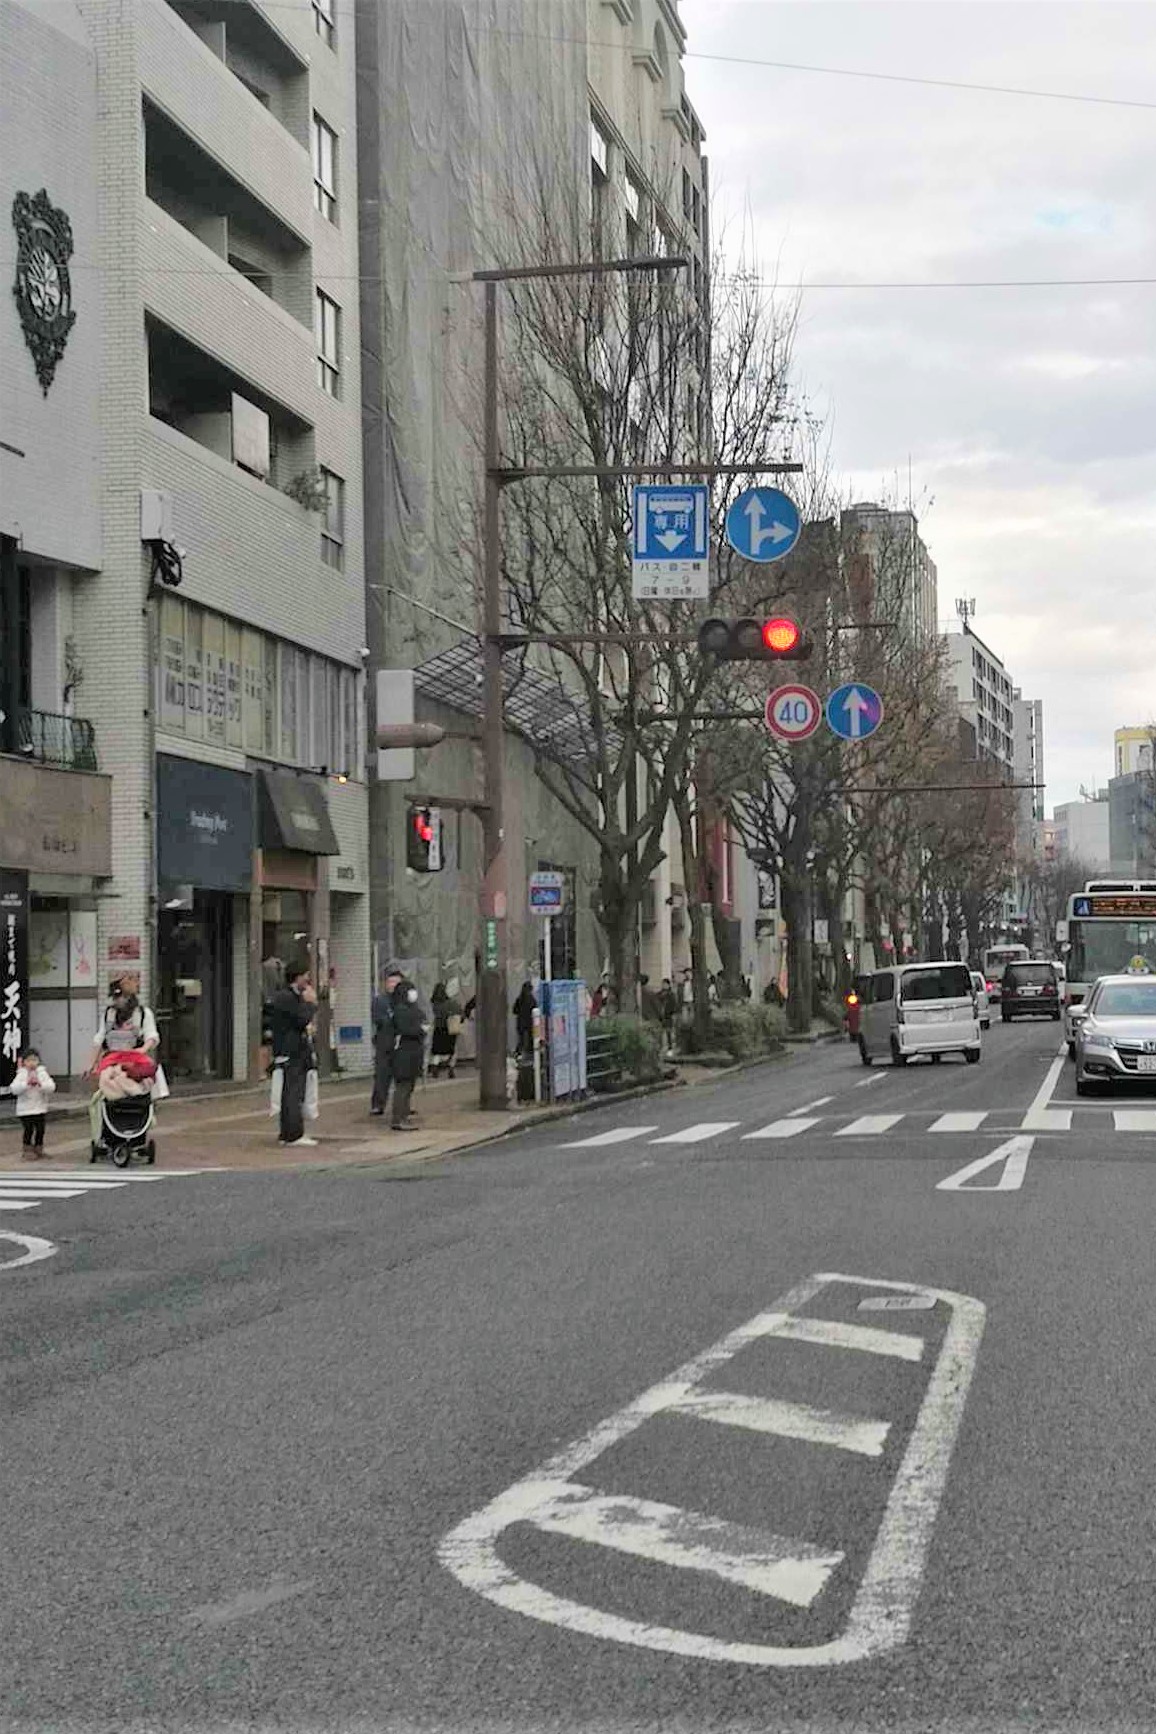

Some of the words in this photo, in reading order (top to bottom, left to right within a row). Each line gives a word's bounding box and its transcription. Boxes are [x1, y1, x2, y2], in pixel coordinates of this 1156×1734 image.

[654, 514, 689, 530] 専用
[779, 701, 808, 724] 40
[0, 980, 22, 1064] 天神
